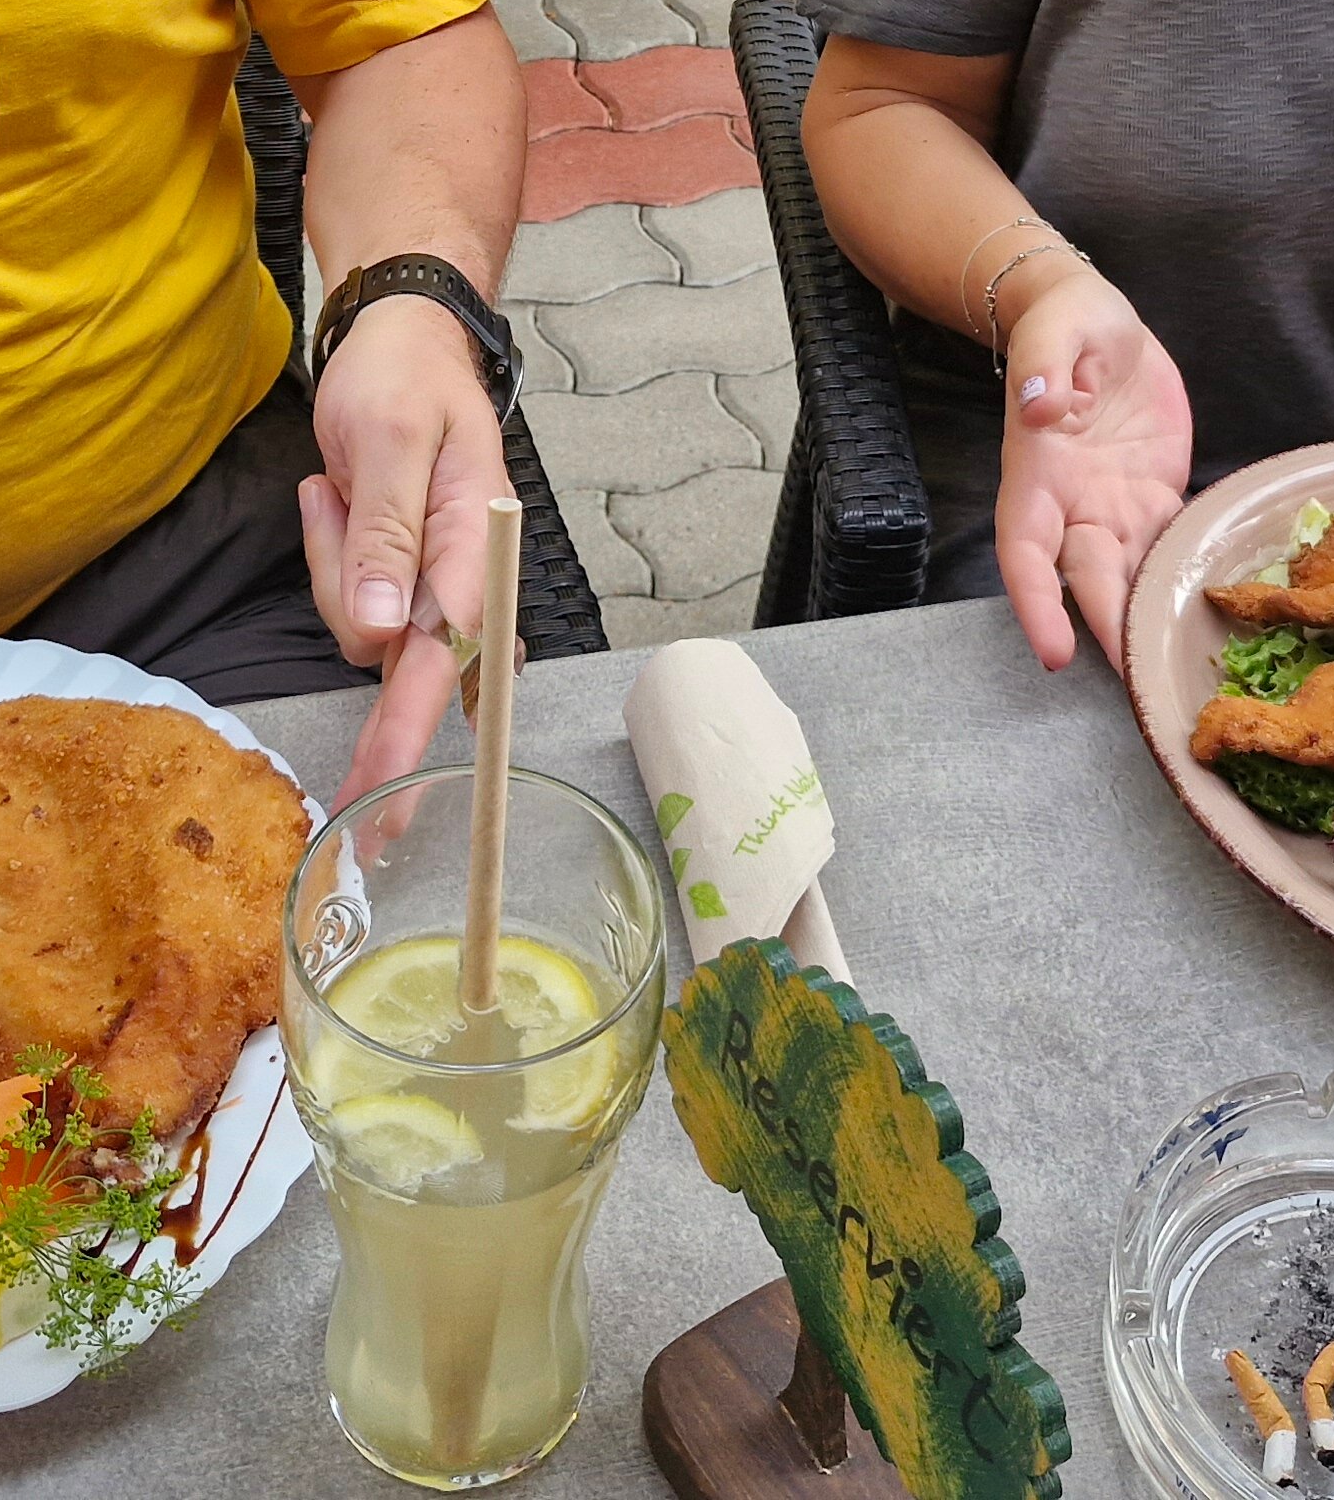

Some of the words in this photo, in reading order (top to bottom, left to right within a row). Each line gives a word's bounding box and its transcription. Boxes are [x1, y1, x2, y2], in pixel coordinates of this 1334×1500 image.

[732, 794, 795, 855] Think
[782, 764, 817, 801] Nat
[720, 1009, 1009, 1465] Reserviert
